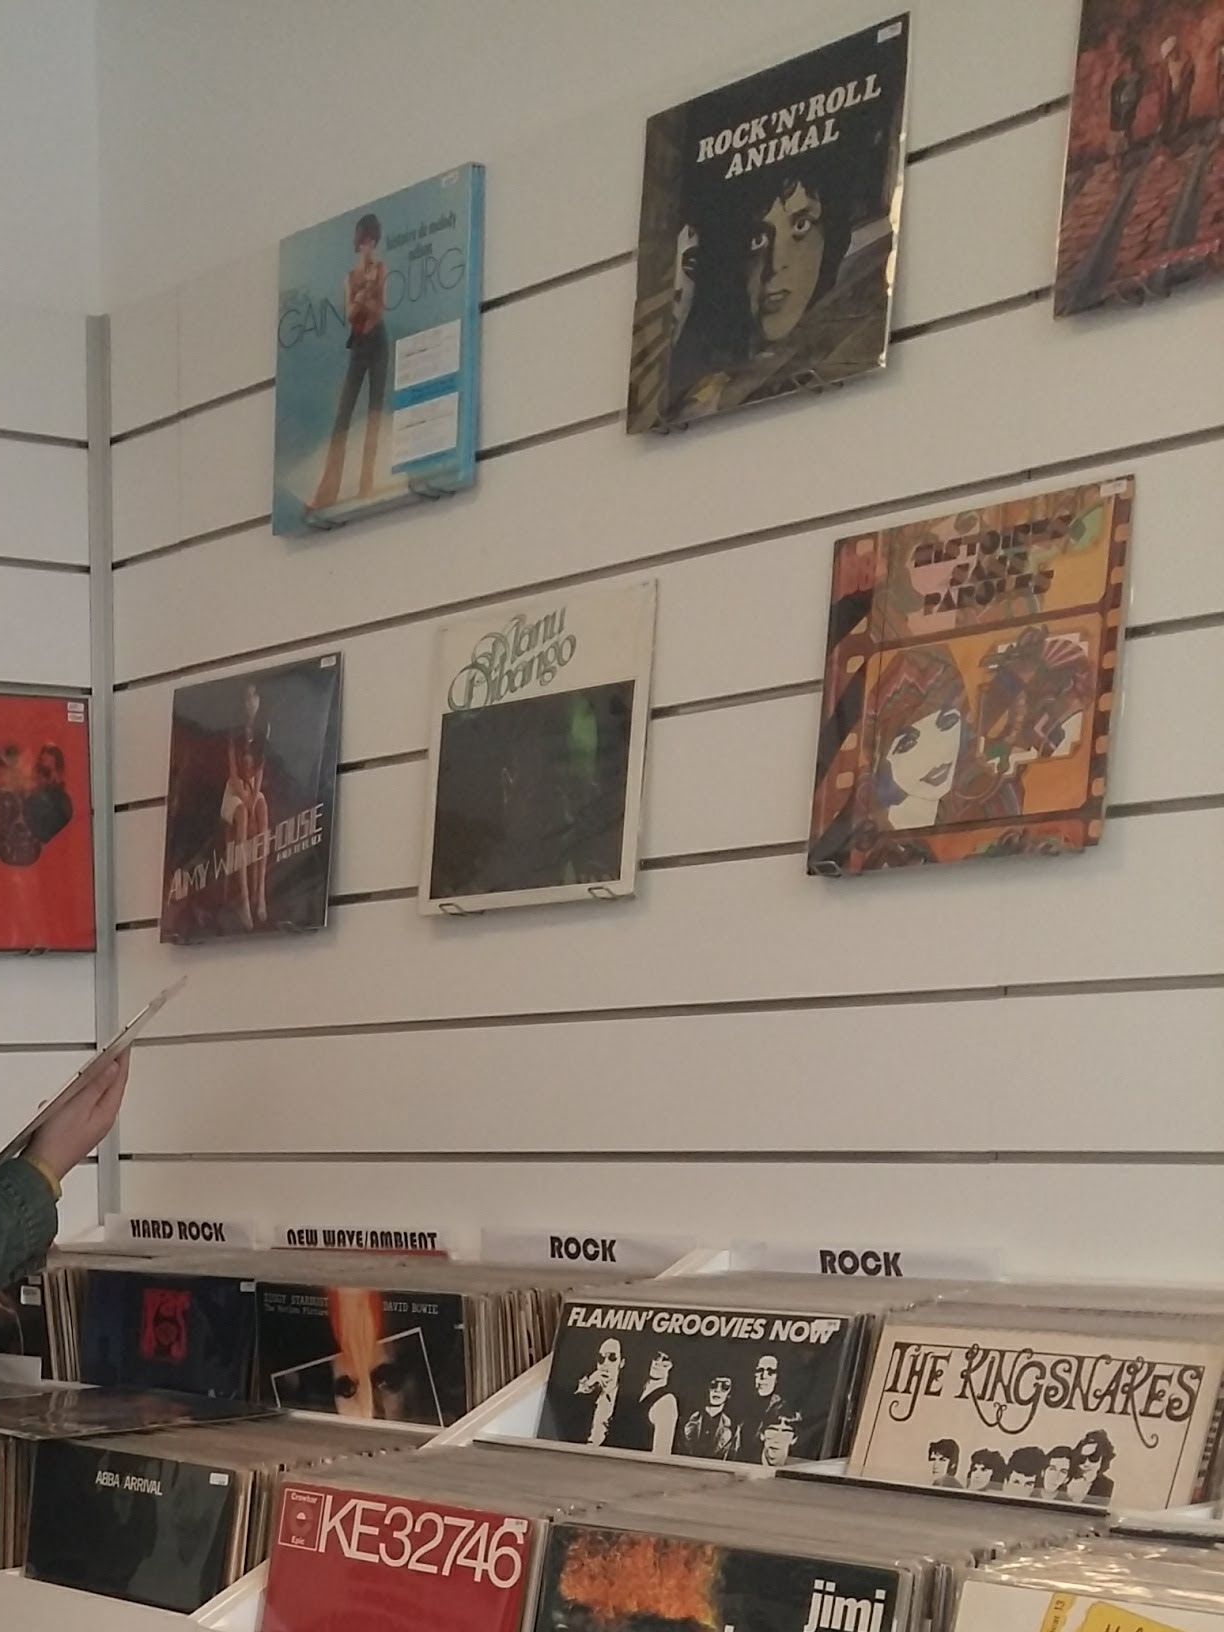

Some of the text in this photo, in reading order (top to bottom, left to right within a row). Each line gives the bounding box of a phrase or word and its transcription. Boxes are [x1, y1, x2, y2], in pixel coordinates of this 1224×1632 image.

[725, 118, 840, 179] ANIMAL
[168, 803, 324, 906] AMY WINEHOUSE
[130, 1219, 226, 1242] HARD ROCK
[287, 1229, 438, 1250] NEW WAVE/AMBIENT
[549, 1236, 617, 1262] ROCK
[819, 1249, 904, 1277] ROCK
[383, 1300, 439, 1315] DAVID BOWIE
[652, 1312, 766, 1340] GROOVIES
[768, 1319, 836, 1344] NOW
[883, 1341, 951, 1421] THE
[95, 1470, 163, 1496] ABBA ARRIVAL
[318, 1495, 524, 1588] KE32746
